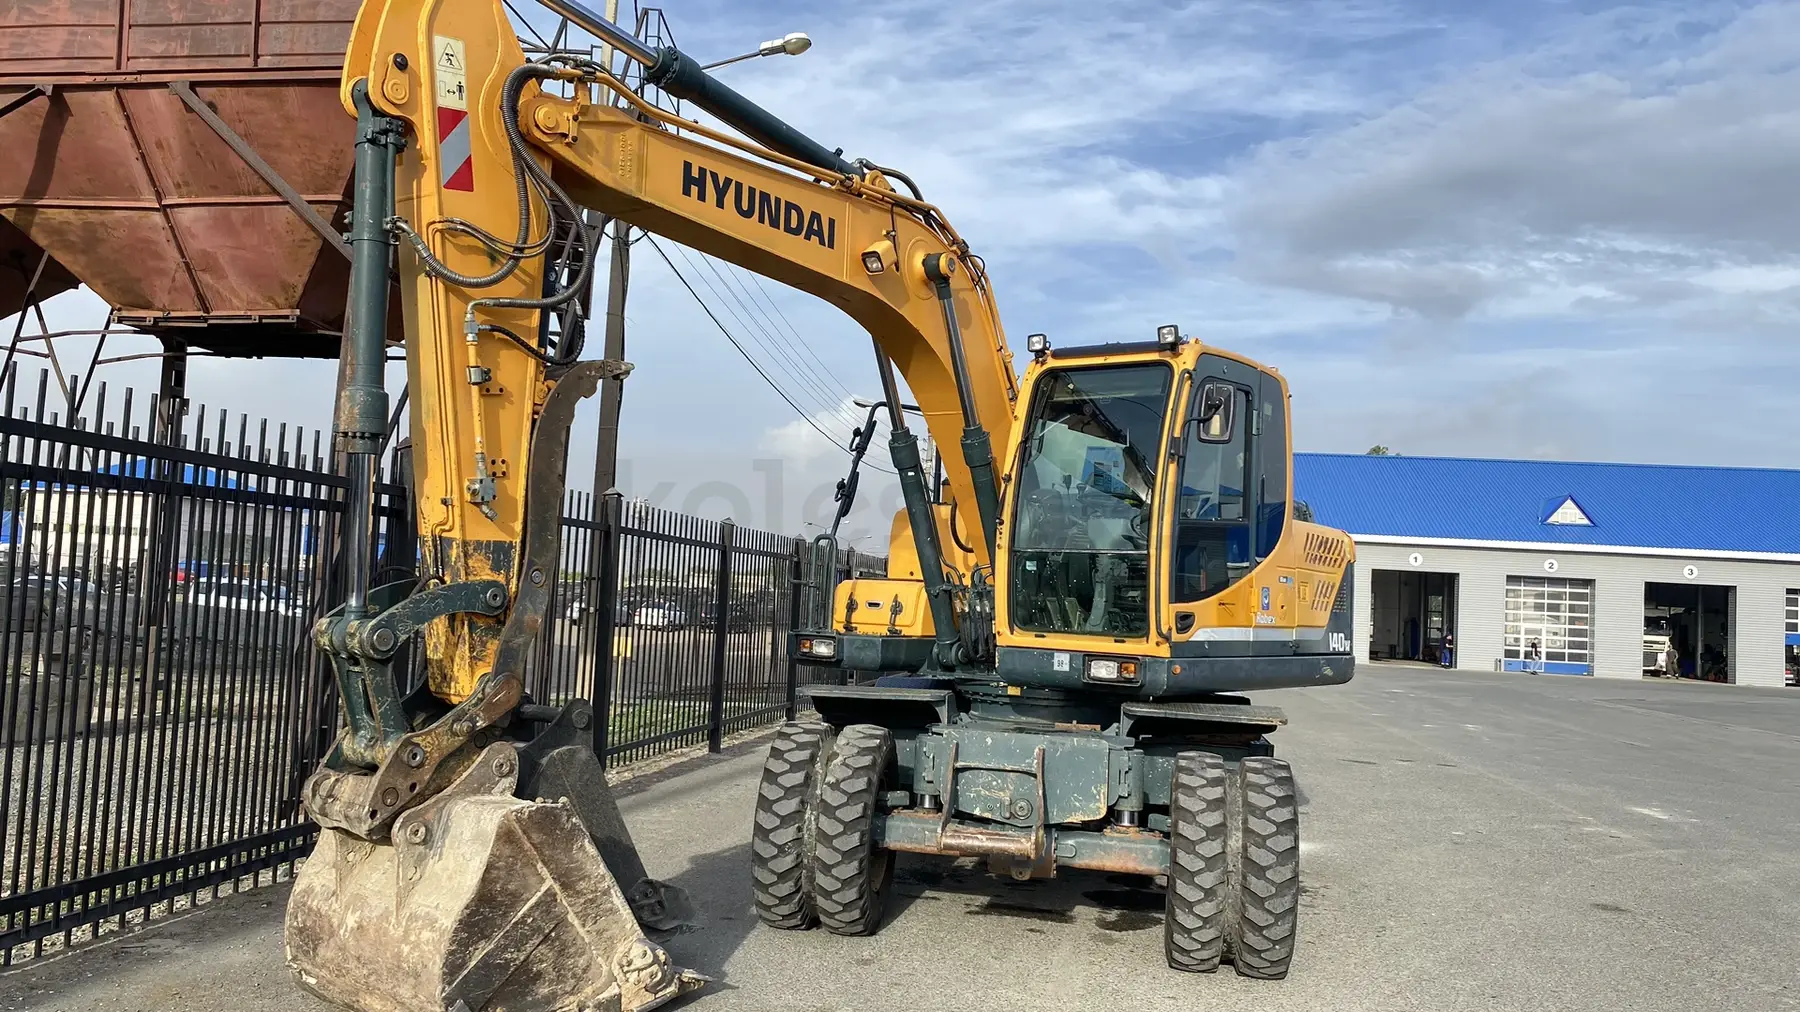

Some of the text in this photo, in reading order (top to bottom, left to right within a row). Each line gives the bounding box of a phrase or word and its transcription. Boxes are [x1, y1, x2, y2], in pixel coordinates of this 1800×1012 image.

[682, 160, 836, 250] HYUNDAI
[1687, 568, 1694, 576] 3
[1256, 612, 1276, 624] Robex
